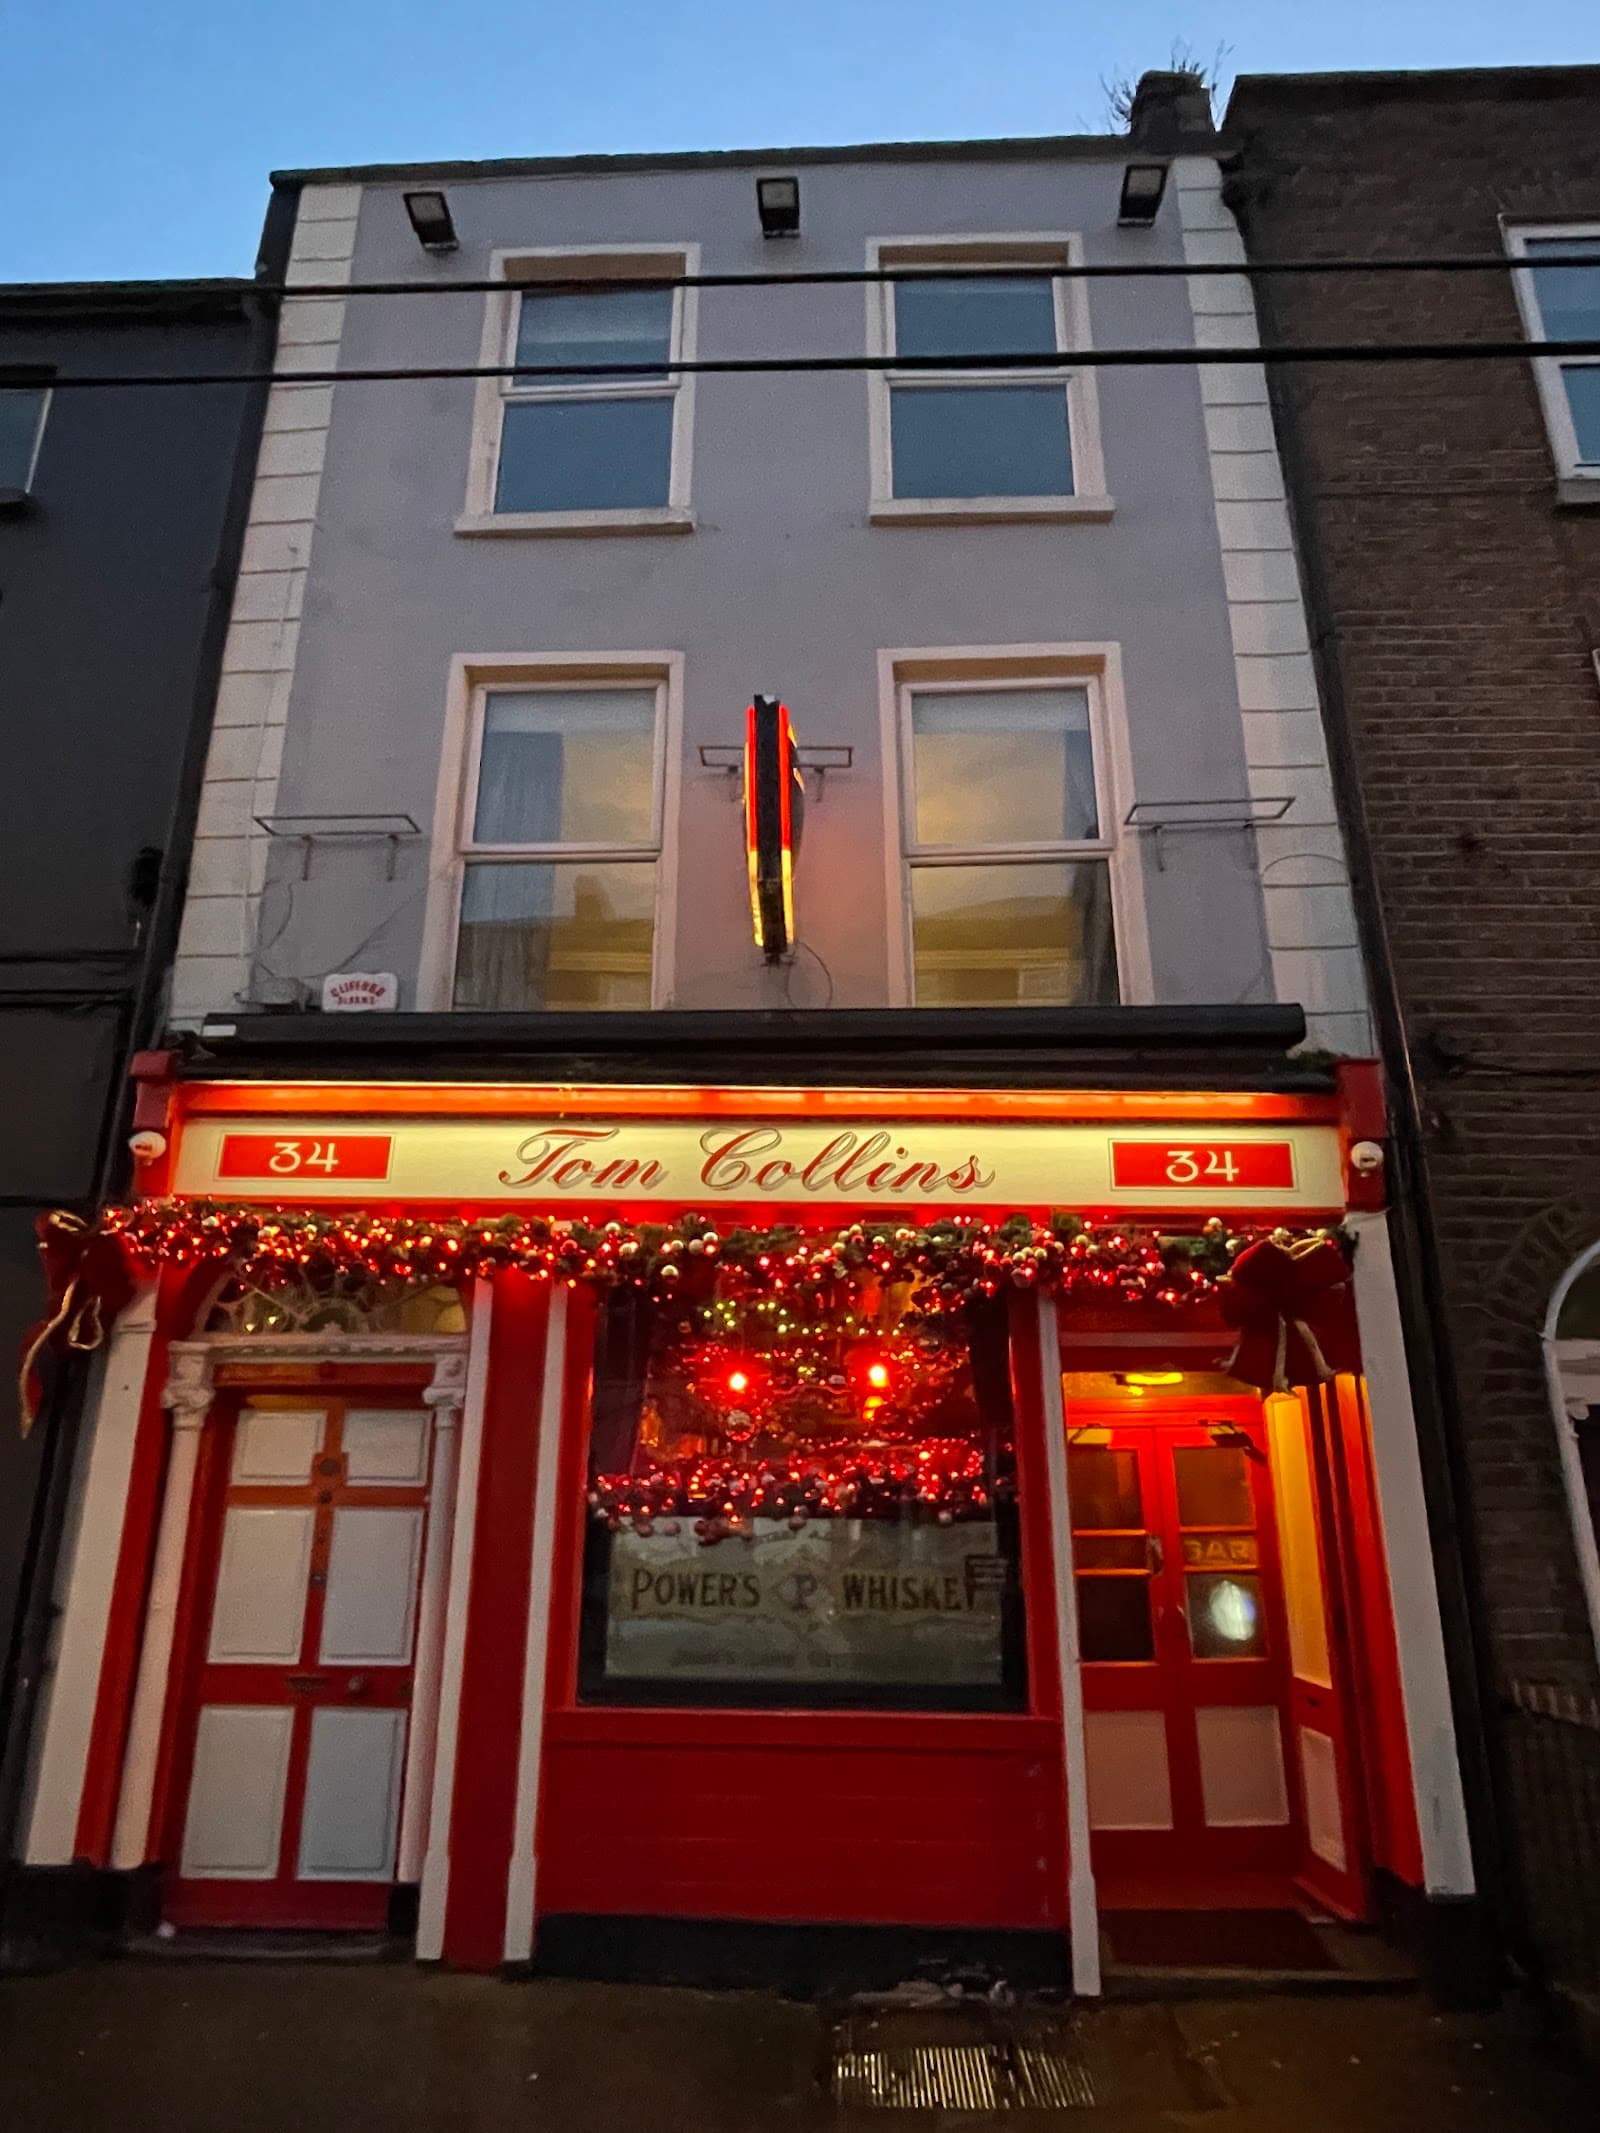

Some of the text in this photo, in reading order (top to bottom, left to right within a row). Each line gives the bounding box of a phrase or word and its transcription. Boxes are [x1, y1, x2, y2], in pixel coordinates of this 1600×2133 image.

[268, 1141, 340, 1173] 34
[498, 1127, 995, 1192] Tom Collins
[1165, 1150, 1240, 1183] 34
